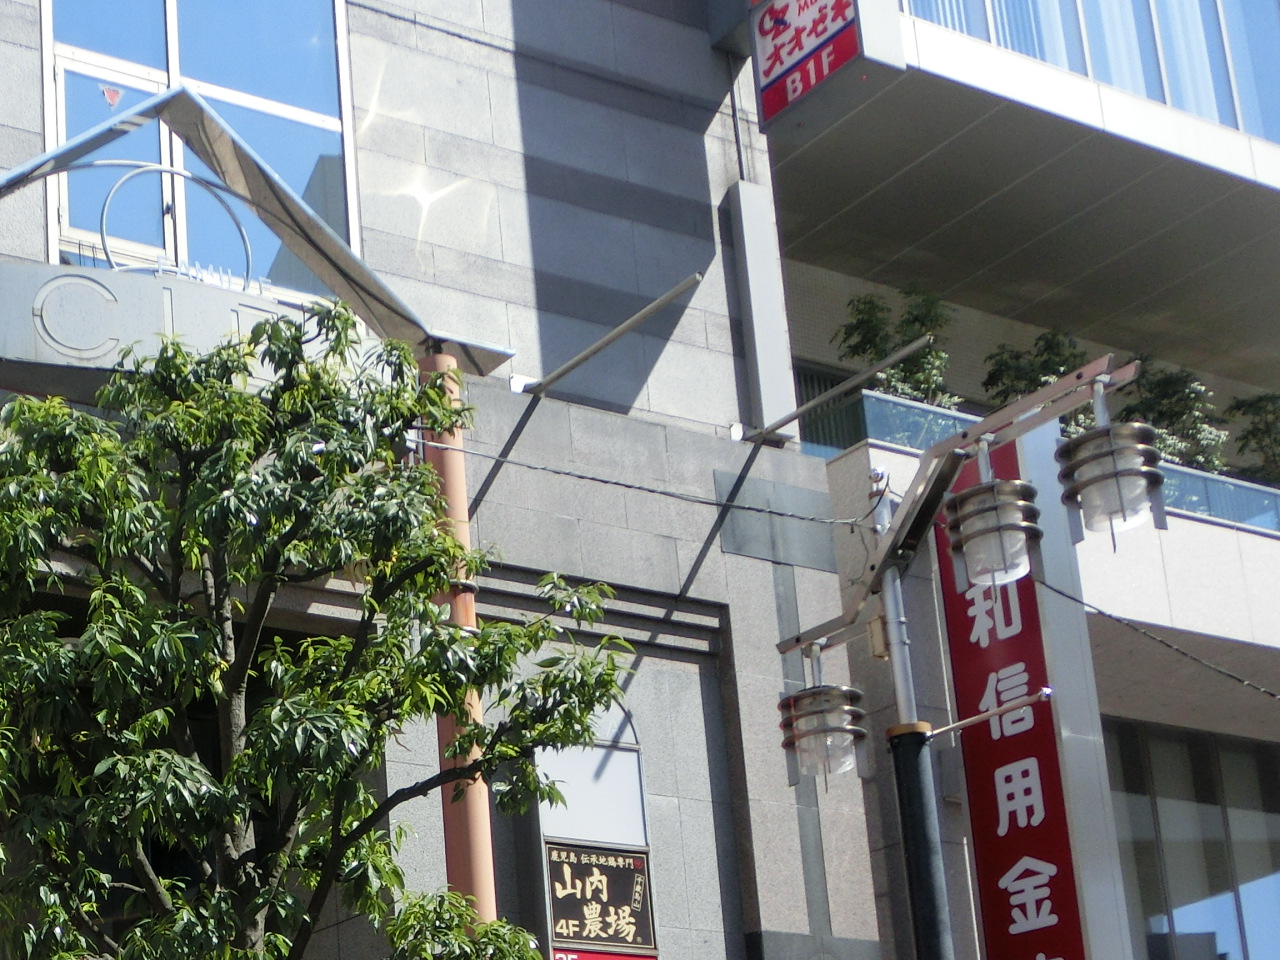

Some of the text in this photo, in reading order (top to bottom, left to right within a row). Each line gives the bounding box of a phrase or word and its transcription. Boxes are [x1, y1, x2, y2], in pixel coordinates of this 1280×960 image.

[785, 44, 835, 102] B1F
[555, 863, 608, 902] 山内
[555, 919, 580, 937] 4F
[582, 901, 636, 942] 農場
